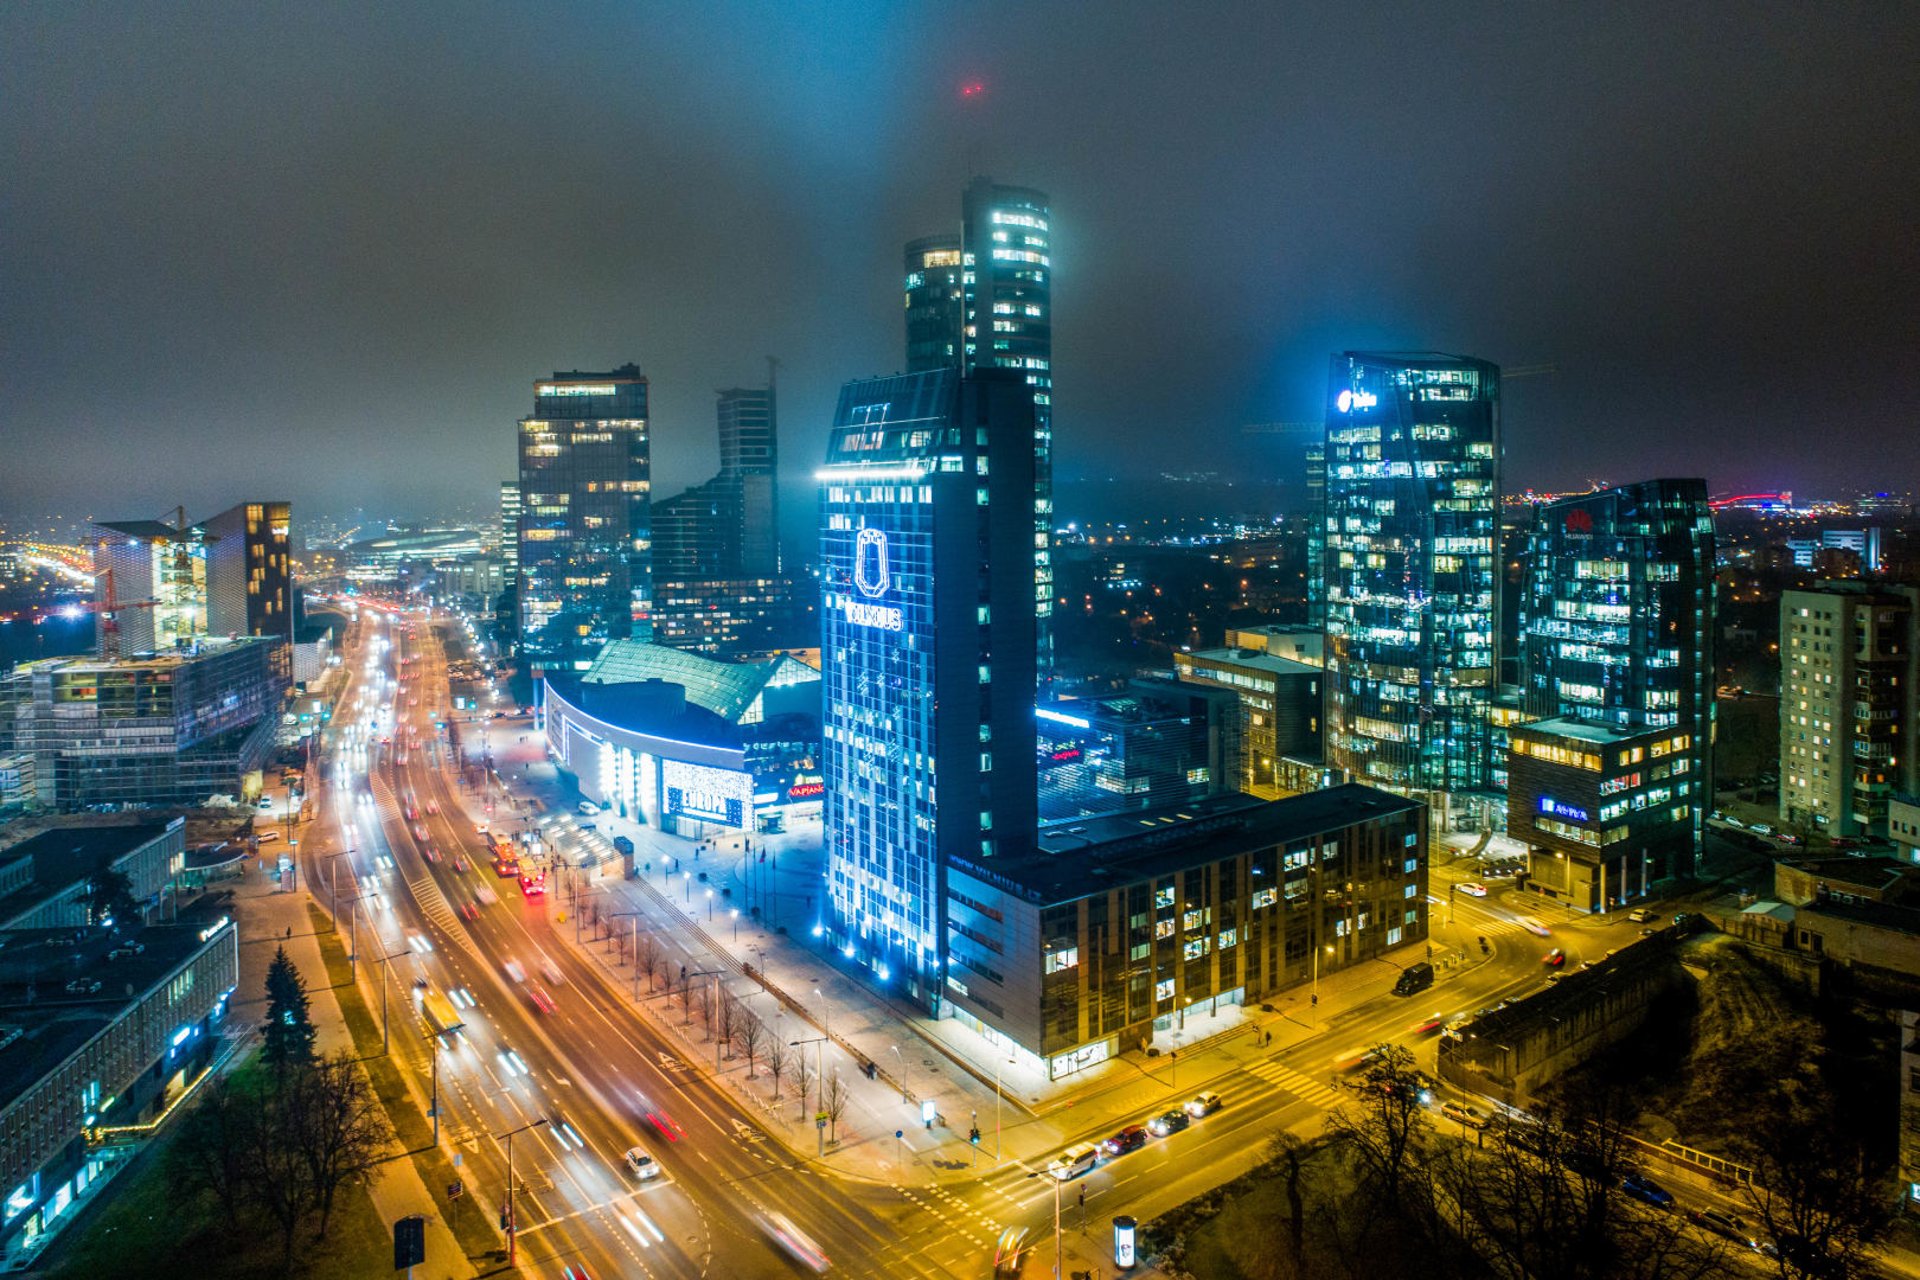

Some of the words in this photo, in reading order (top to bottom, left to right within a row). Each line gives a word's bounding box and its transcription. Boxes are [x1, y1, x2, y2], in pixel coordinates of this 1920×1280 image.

[1565, 533, 1594, 541] HUAWEI
[845, 601, 903, 632] VILNIUS
[683, 790, 728, 813] EUROPA
